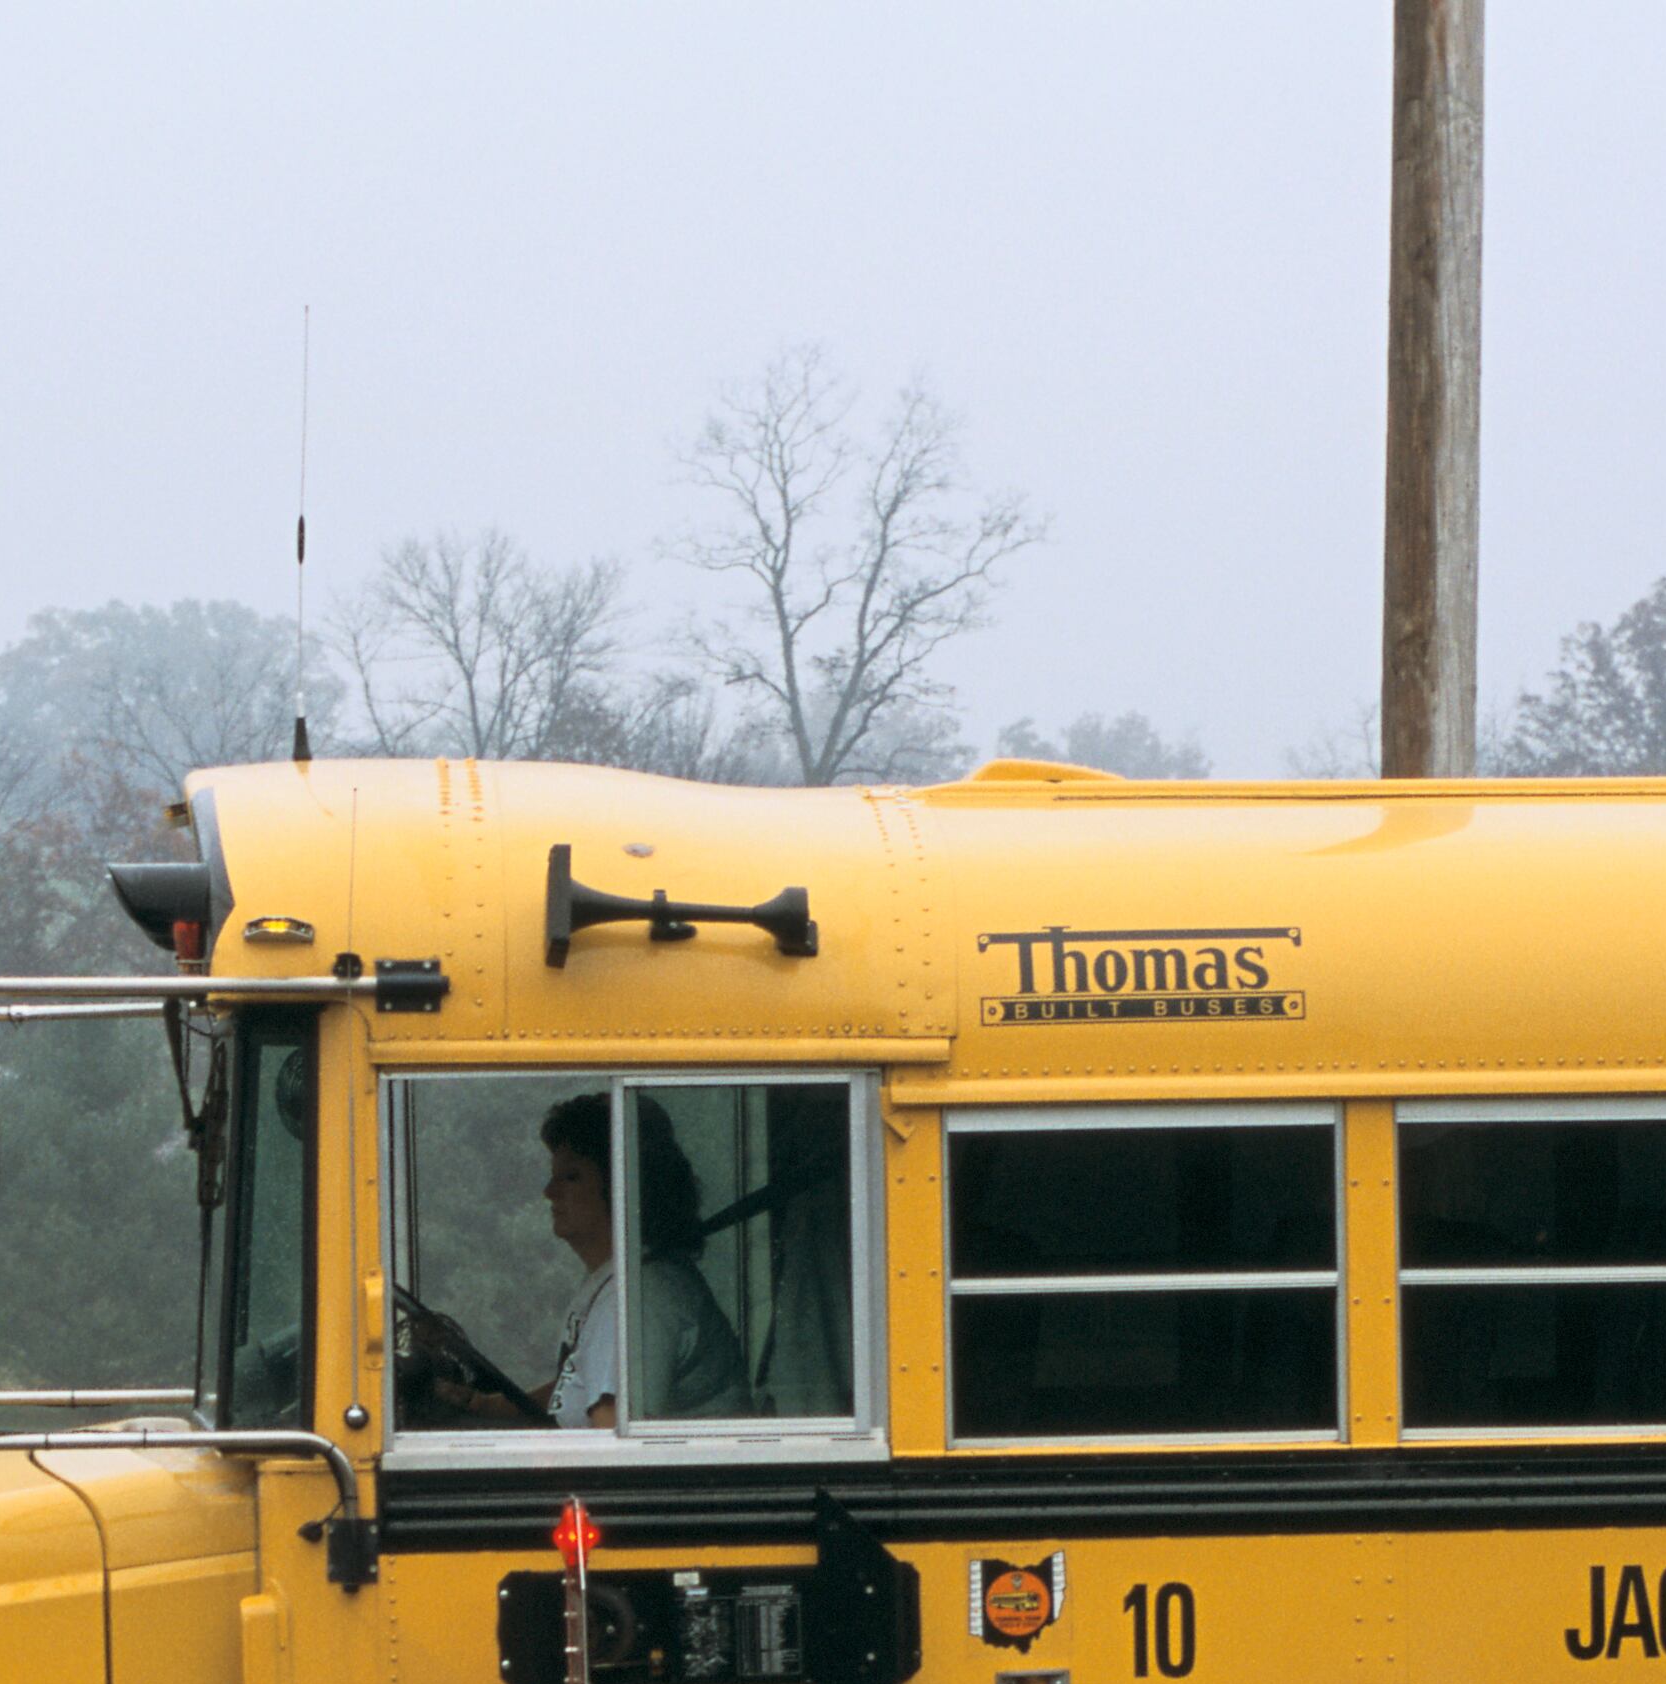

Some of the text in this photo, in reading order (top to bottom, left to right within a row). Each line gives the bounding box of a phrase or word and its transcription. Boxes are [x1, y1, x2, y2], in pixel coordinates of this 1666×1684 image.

[1013, 925, 1271, 995] Thomas
[1014, 998, 1275, 1020] BUILT BUSES
[1123, 1582, 1196, 1678] 10
